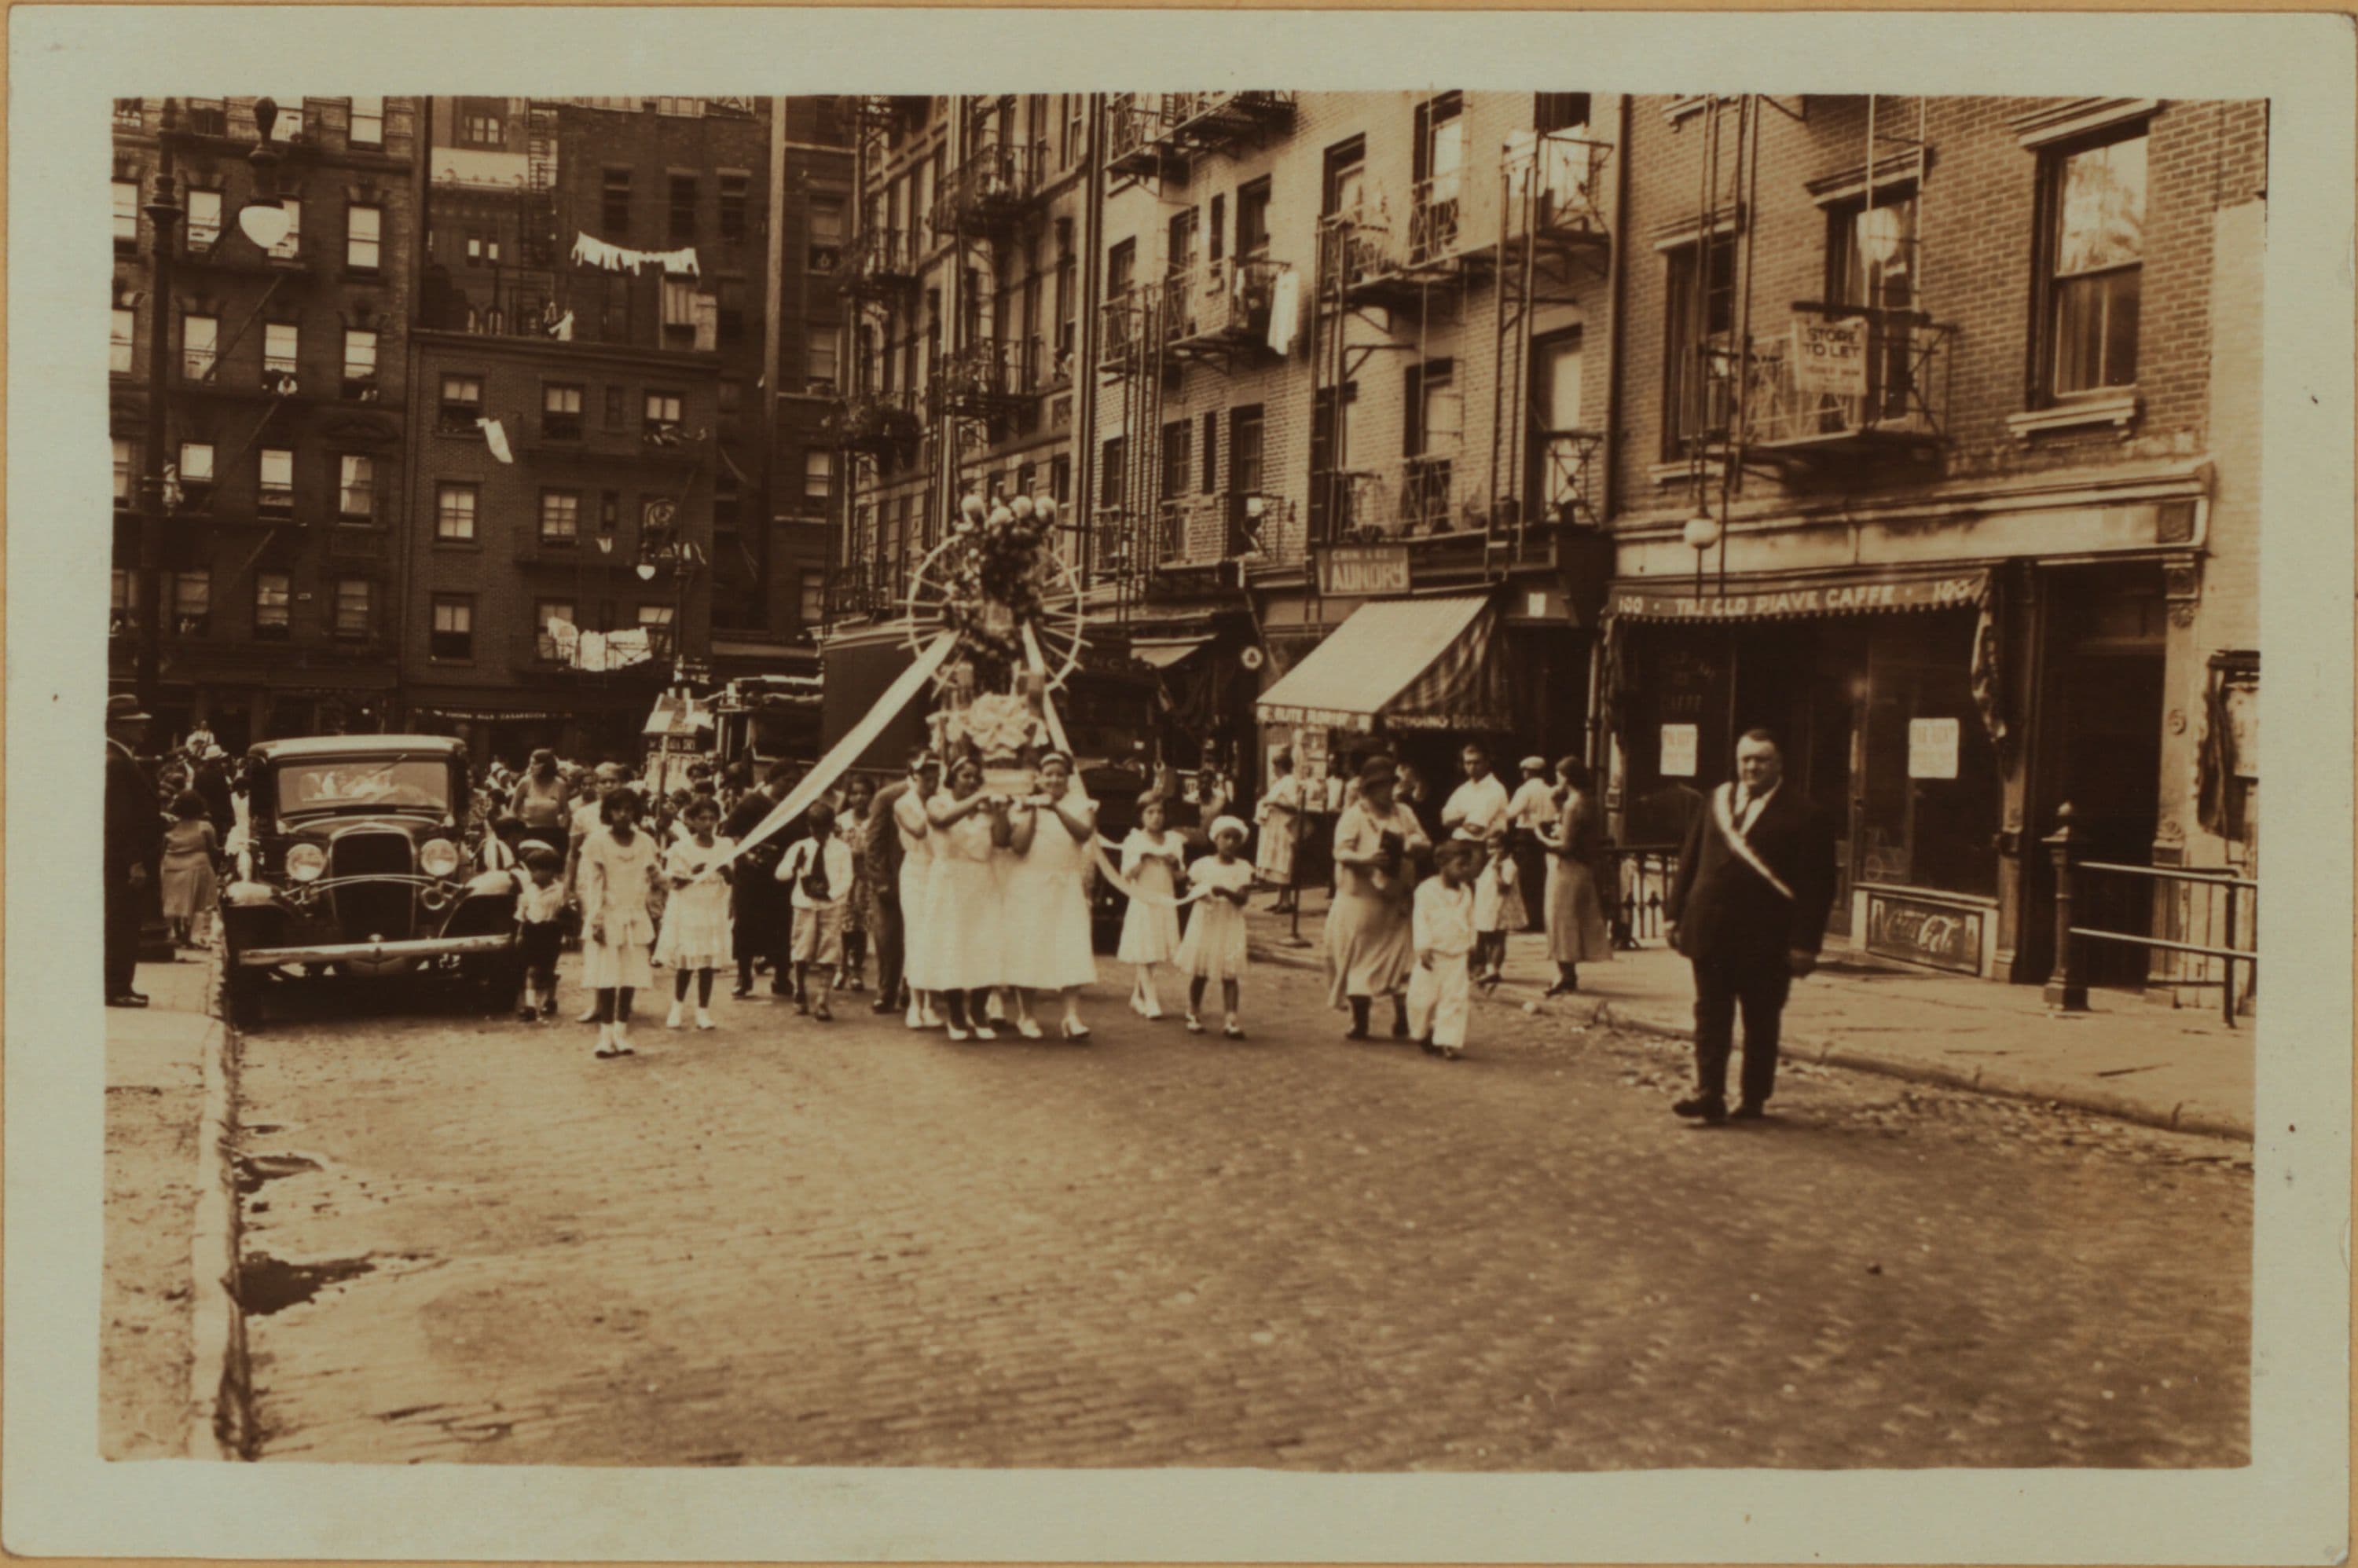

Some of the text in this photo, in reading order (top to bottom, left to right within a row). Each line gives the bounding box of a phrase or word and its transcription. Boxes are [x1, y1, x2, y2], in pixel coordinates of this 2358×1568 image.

[1807, 328, 1855, 345] STORE
[1802, 343, 1861, 359] TO LET
[1318, 561, 1406, 592] LAUNDRY
[1618, 595, 1644, 614] 100
[1755, 591, 1818, 613] PIAVE
[1825, 584, 1895, 608] CAFFE
